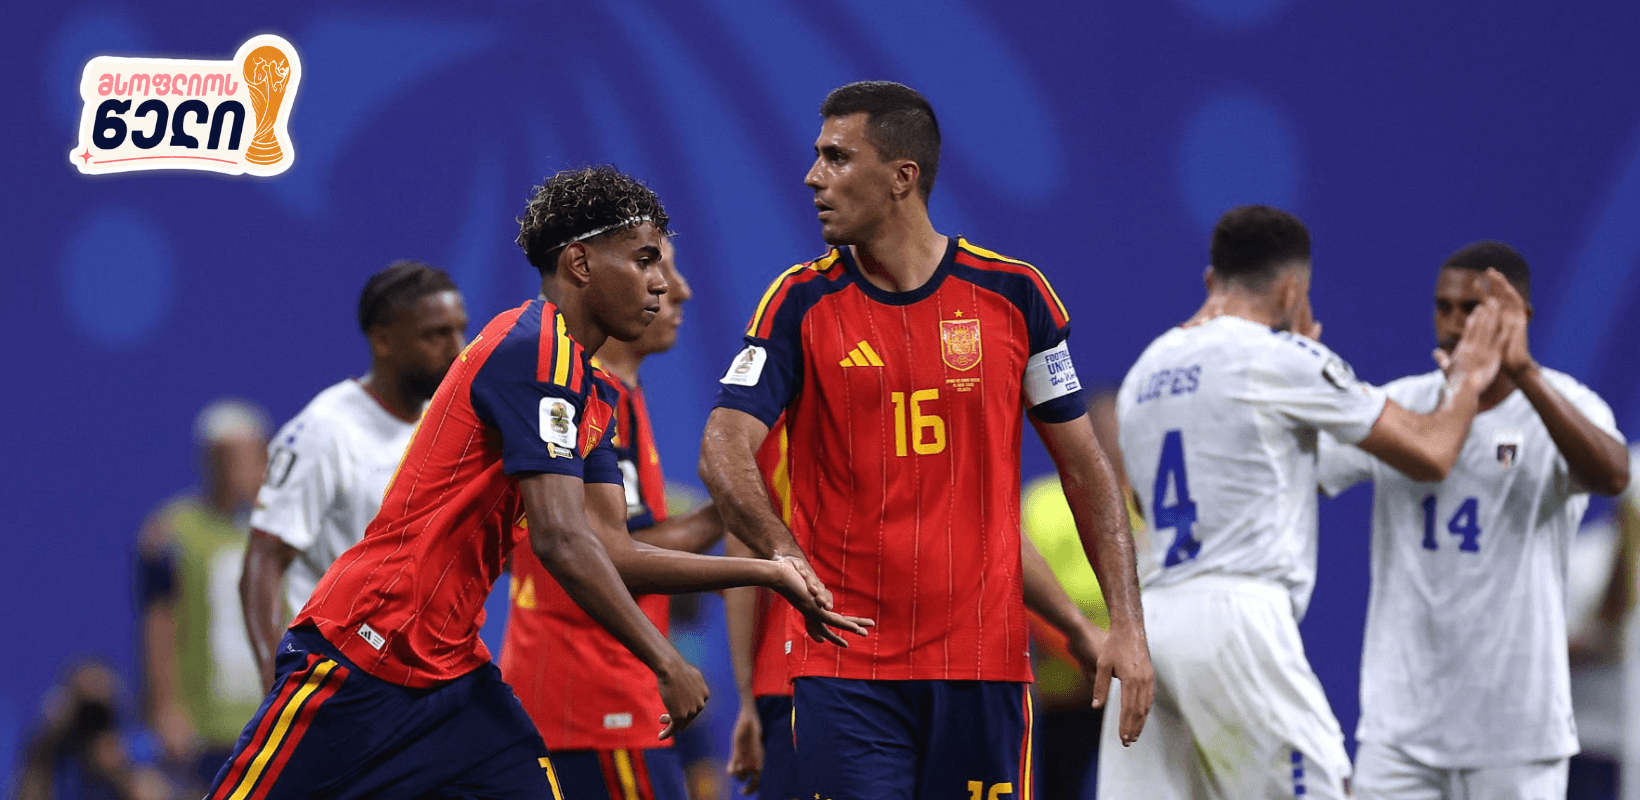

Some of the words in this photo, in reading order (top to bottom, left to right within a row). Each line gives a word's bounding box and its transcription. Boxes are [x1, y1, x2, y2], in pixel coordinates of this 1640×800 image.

[1137, 364, 1201, 403] LOPES
[892, 389, 946, 456] 16
[1152, 429, 1203, 569] 4
[1421, 493, 1482, 553] 14
